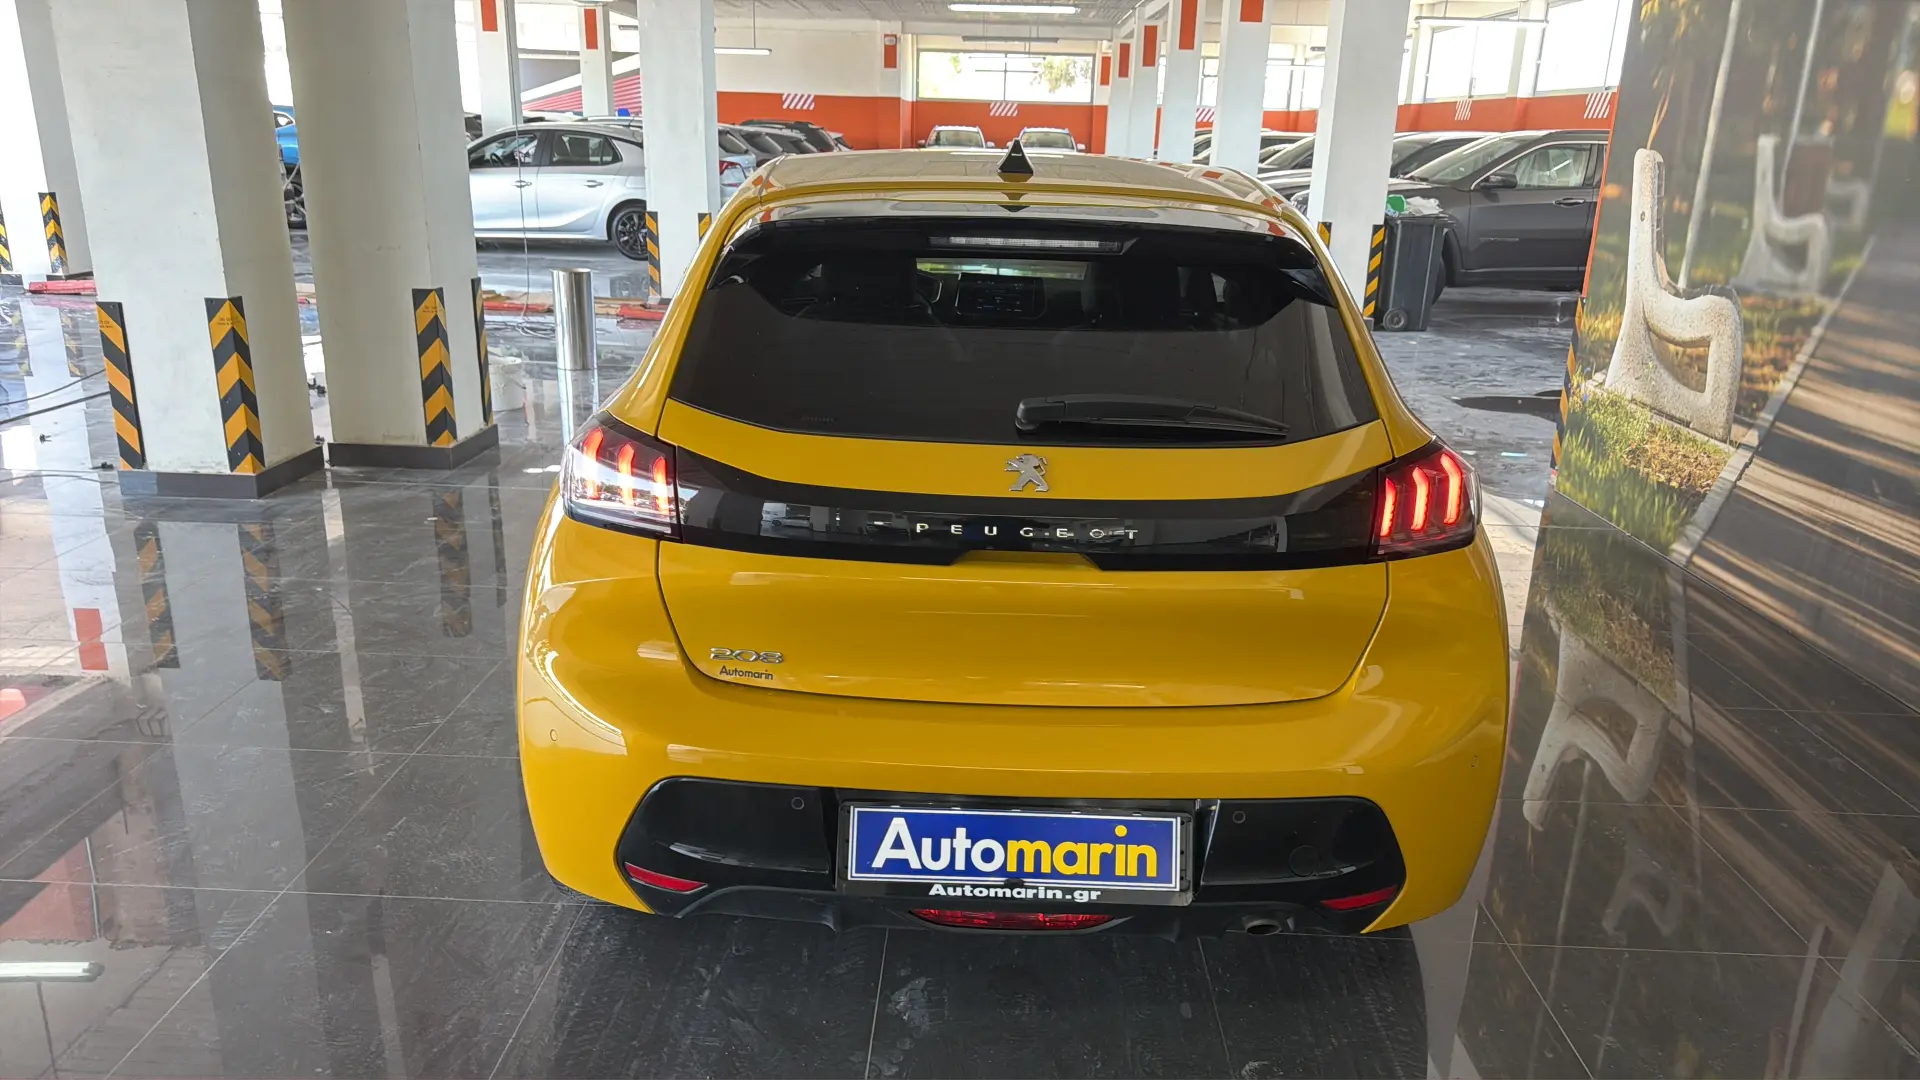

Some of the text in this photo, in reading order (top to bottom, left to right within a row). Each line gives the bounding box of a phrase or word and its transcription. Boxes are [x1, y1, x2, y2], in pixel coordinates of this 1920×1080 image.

[915, 522, 1139, 540] PEUGEOT
[710, 647, 783, 664] 208
[719, 665, 774, 680] Automarin
[871, 817, 1158, 878] Automarin
[928, 884, 1102, 902] Automarin.gr
